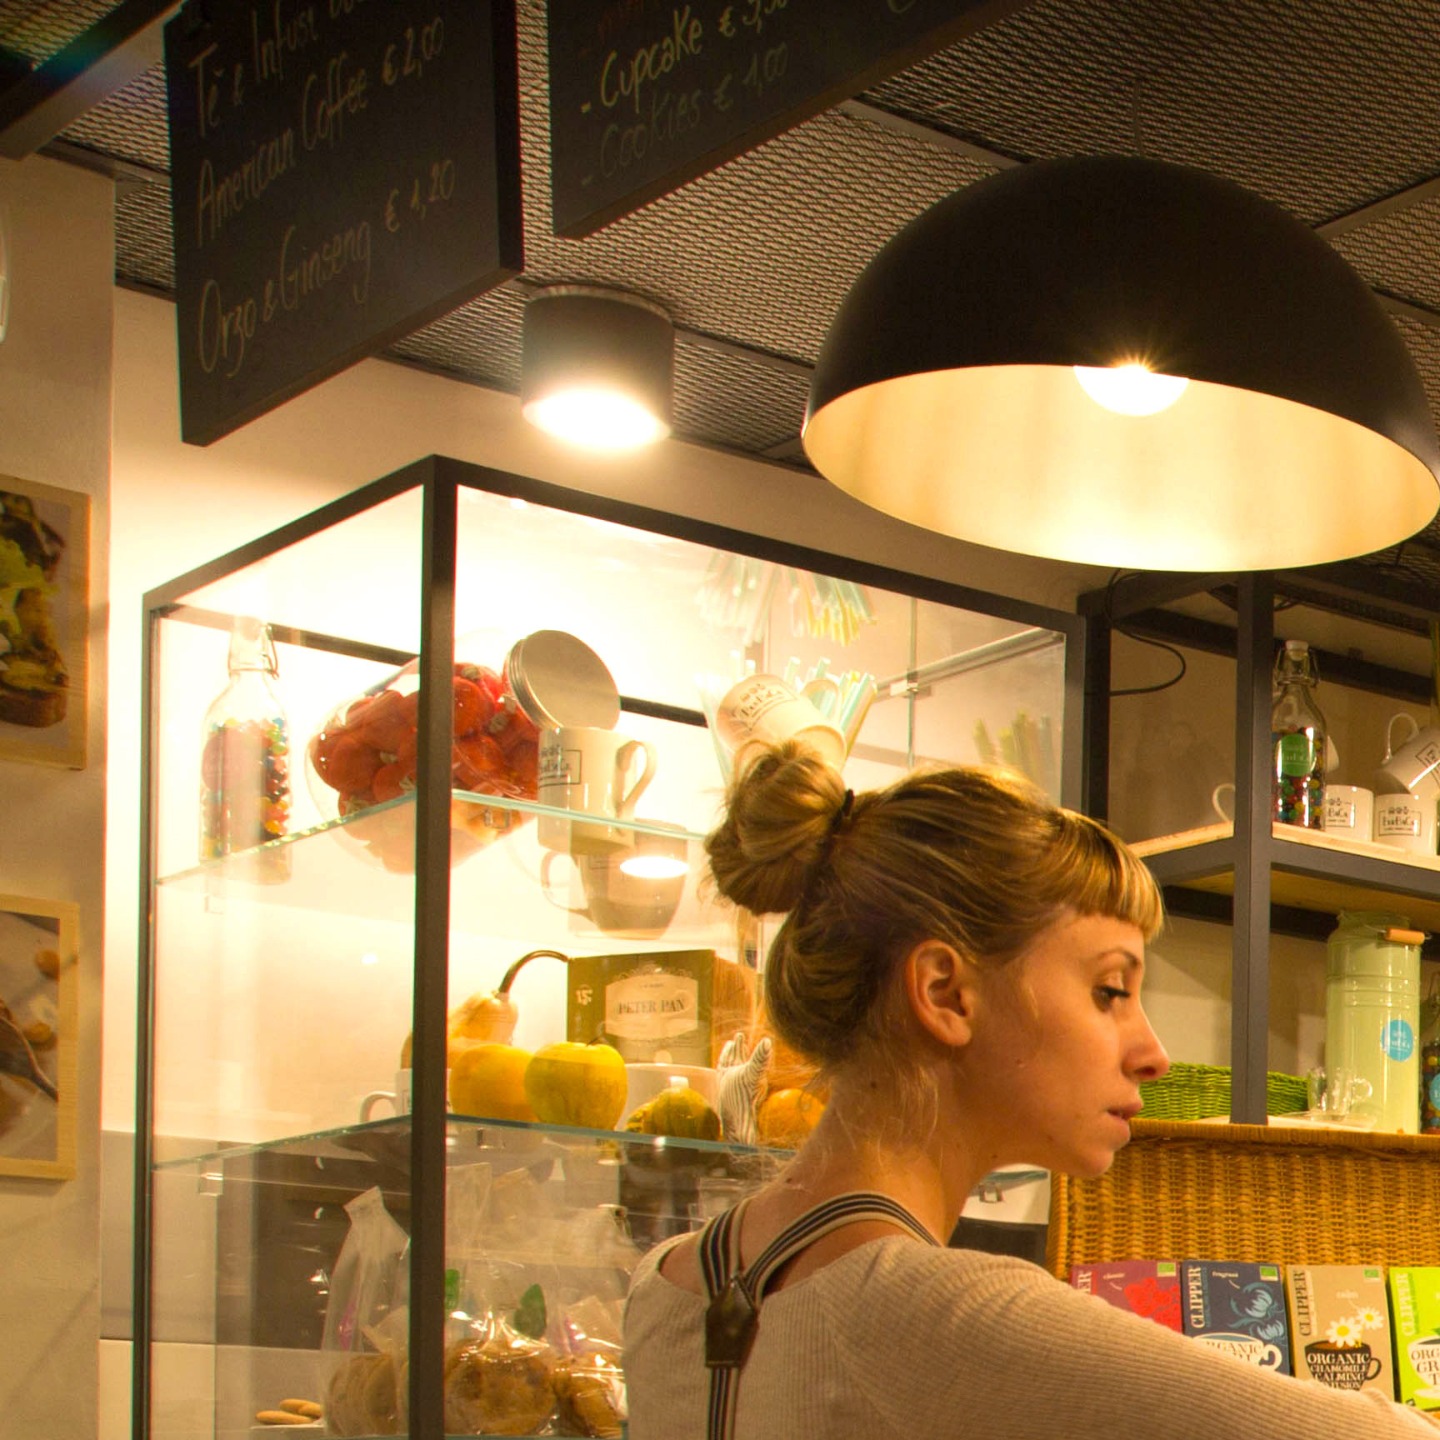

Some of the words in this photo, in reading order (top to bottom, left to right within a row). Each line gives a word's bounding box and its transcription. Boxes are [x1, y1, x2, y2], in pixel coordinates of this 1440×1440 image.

[197, 127, 297, 248] American
[302, 52, 368, 151] Coffee
[1187, 1265, 1206, 1329] CLIPPER
[1293, 1270, 1312, 1337] CLIPPER
[1395, 1272, 1414, 1337] CLIPPER
[1306, 1352, 1370, 1365] ORGANIC
